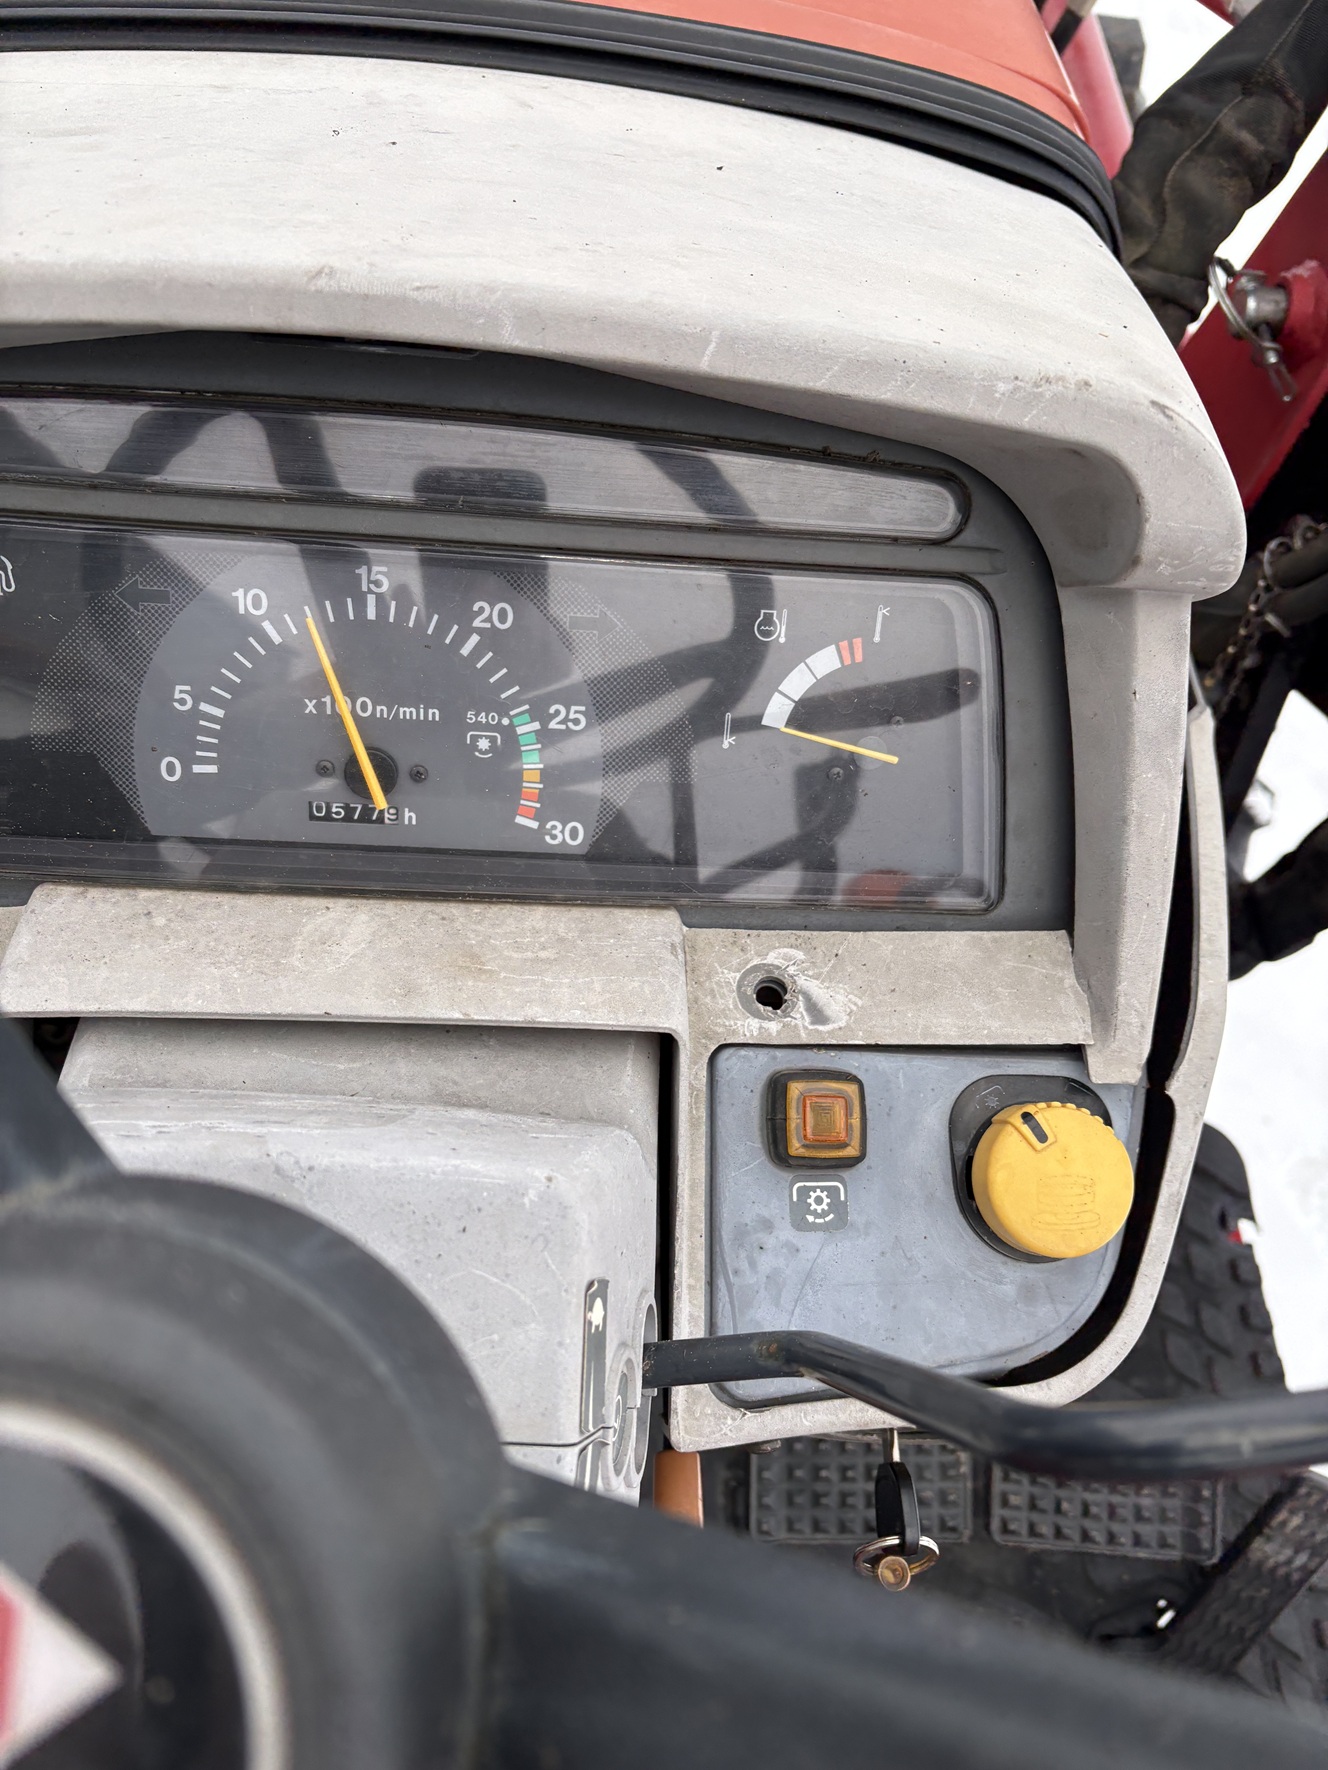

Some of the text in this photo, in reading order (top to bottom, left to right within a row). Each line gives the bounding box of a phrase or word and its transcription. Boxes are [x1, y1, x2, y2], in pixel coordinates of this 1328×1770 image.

[355, 565, 389, 593] 15
[231, 588, 268, 616] 10
[472, 601, 514, 630] 20
[172, 684, 194, 711] 5
[466, 711, 499, 724] 540
[548, 704, 587, 731] 25
[160, 756, 182, 782] 0
[312, 801, 417, 825] 05779 h
[544, 820, 585, 846] 30
